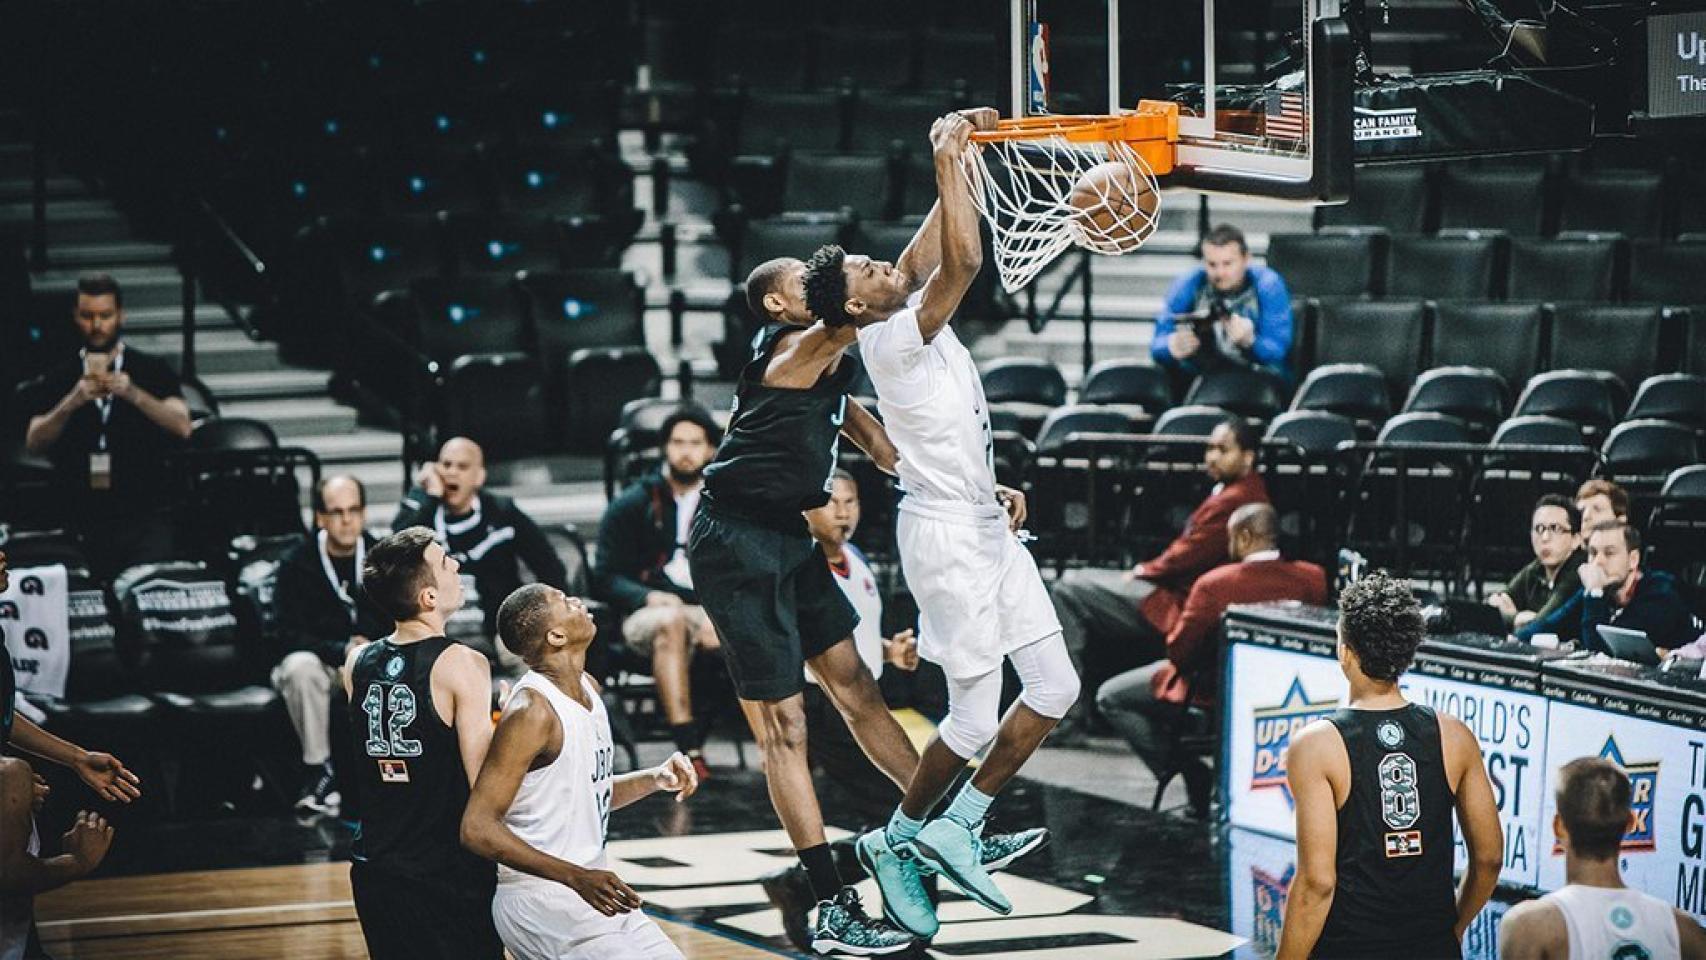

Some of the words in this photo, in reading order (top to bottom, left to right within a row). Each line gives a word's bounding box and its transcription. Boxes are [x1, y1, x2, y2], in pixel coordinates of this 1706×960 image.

[1378, 114, 1416, 127] FAMILY
[361, 684, 423, 757] 12
[1377, 752, 1421, 830] 8
